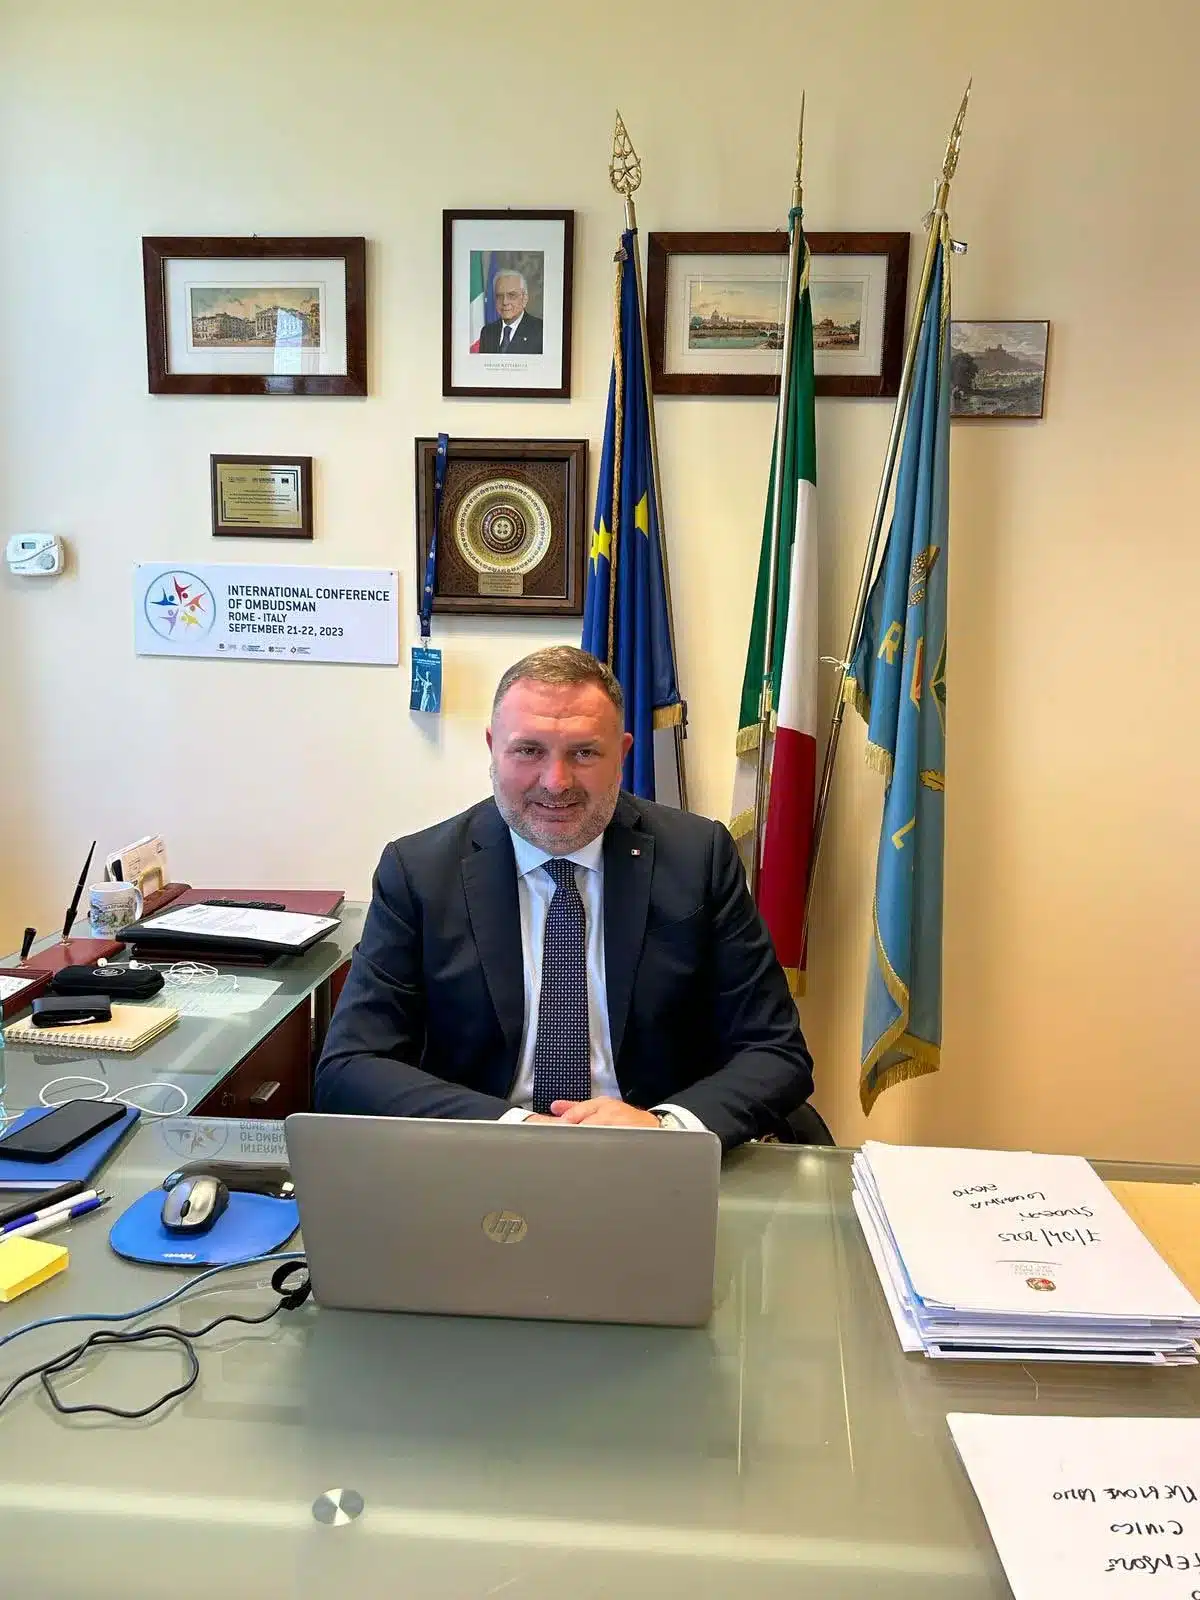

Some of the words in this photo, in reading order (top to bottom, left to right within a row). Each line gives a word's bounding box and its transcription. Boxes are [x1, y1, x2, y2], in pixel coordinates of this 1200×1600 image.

[228, 585, 313, 599] INTERNATIONAL
[316, 588, 390, 602] CONFERENCE
[228, 598, 242, 609] OF
[245, 599, 316, 612] OMBUDSMAN
[228, 612, 256, 622] ROME
[263, 613, 287, 623] ITALY
[228, 623, 285, 634] SEPTEMBER
[287, 625, 317, 637] 21-22,
[319, 626, 344, 637] 2023
